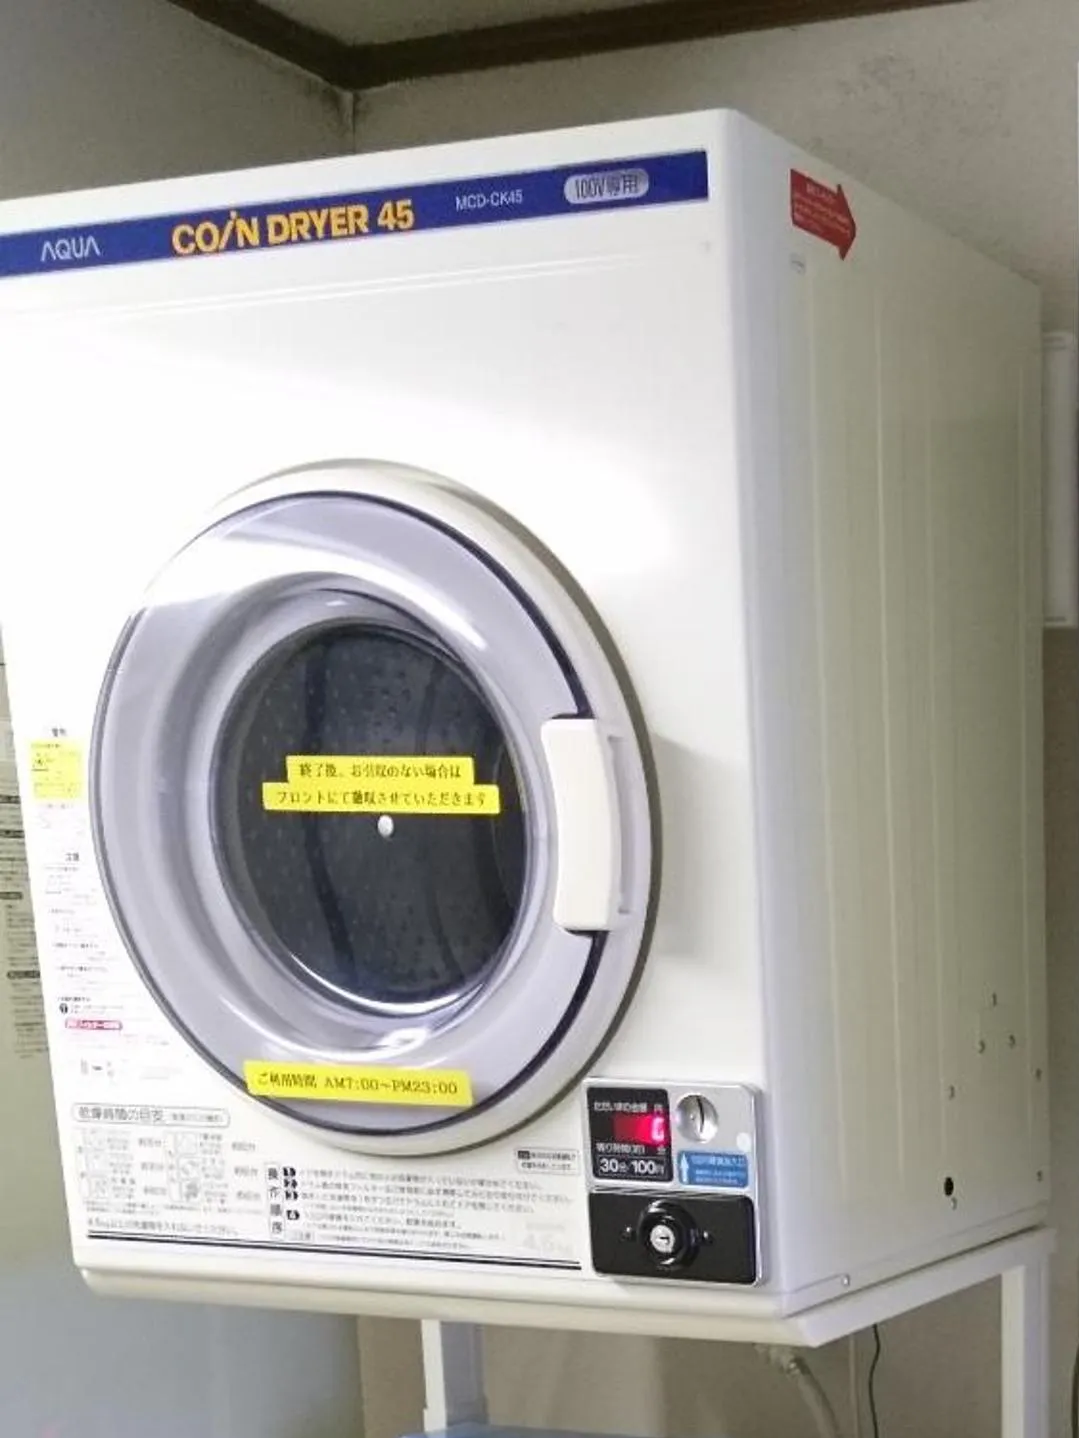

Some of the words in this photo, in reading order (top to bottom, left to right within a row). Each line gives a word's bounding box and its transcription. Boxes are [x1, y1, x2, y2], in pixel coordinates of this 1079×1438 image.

[455, 189, 523, 212] MCD-CK45
[267, 204, 369, 246] DRYER
[377, 199, 414, 230] 45
[41, 235, 100, 262] AQUA
